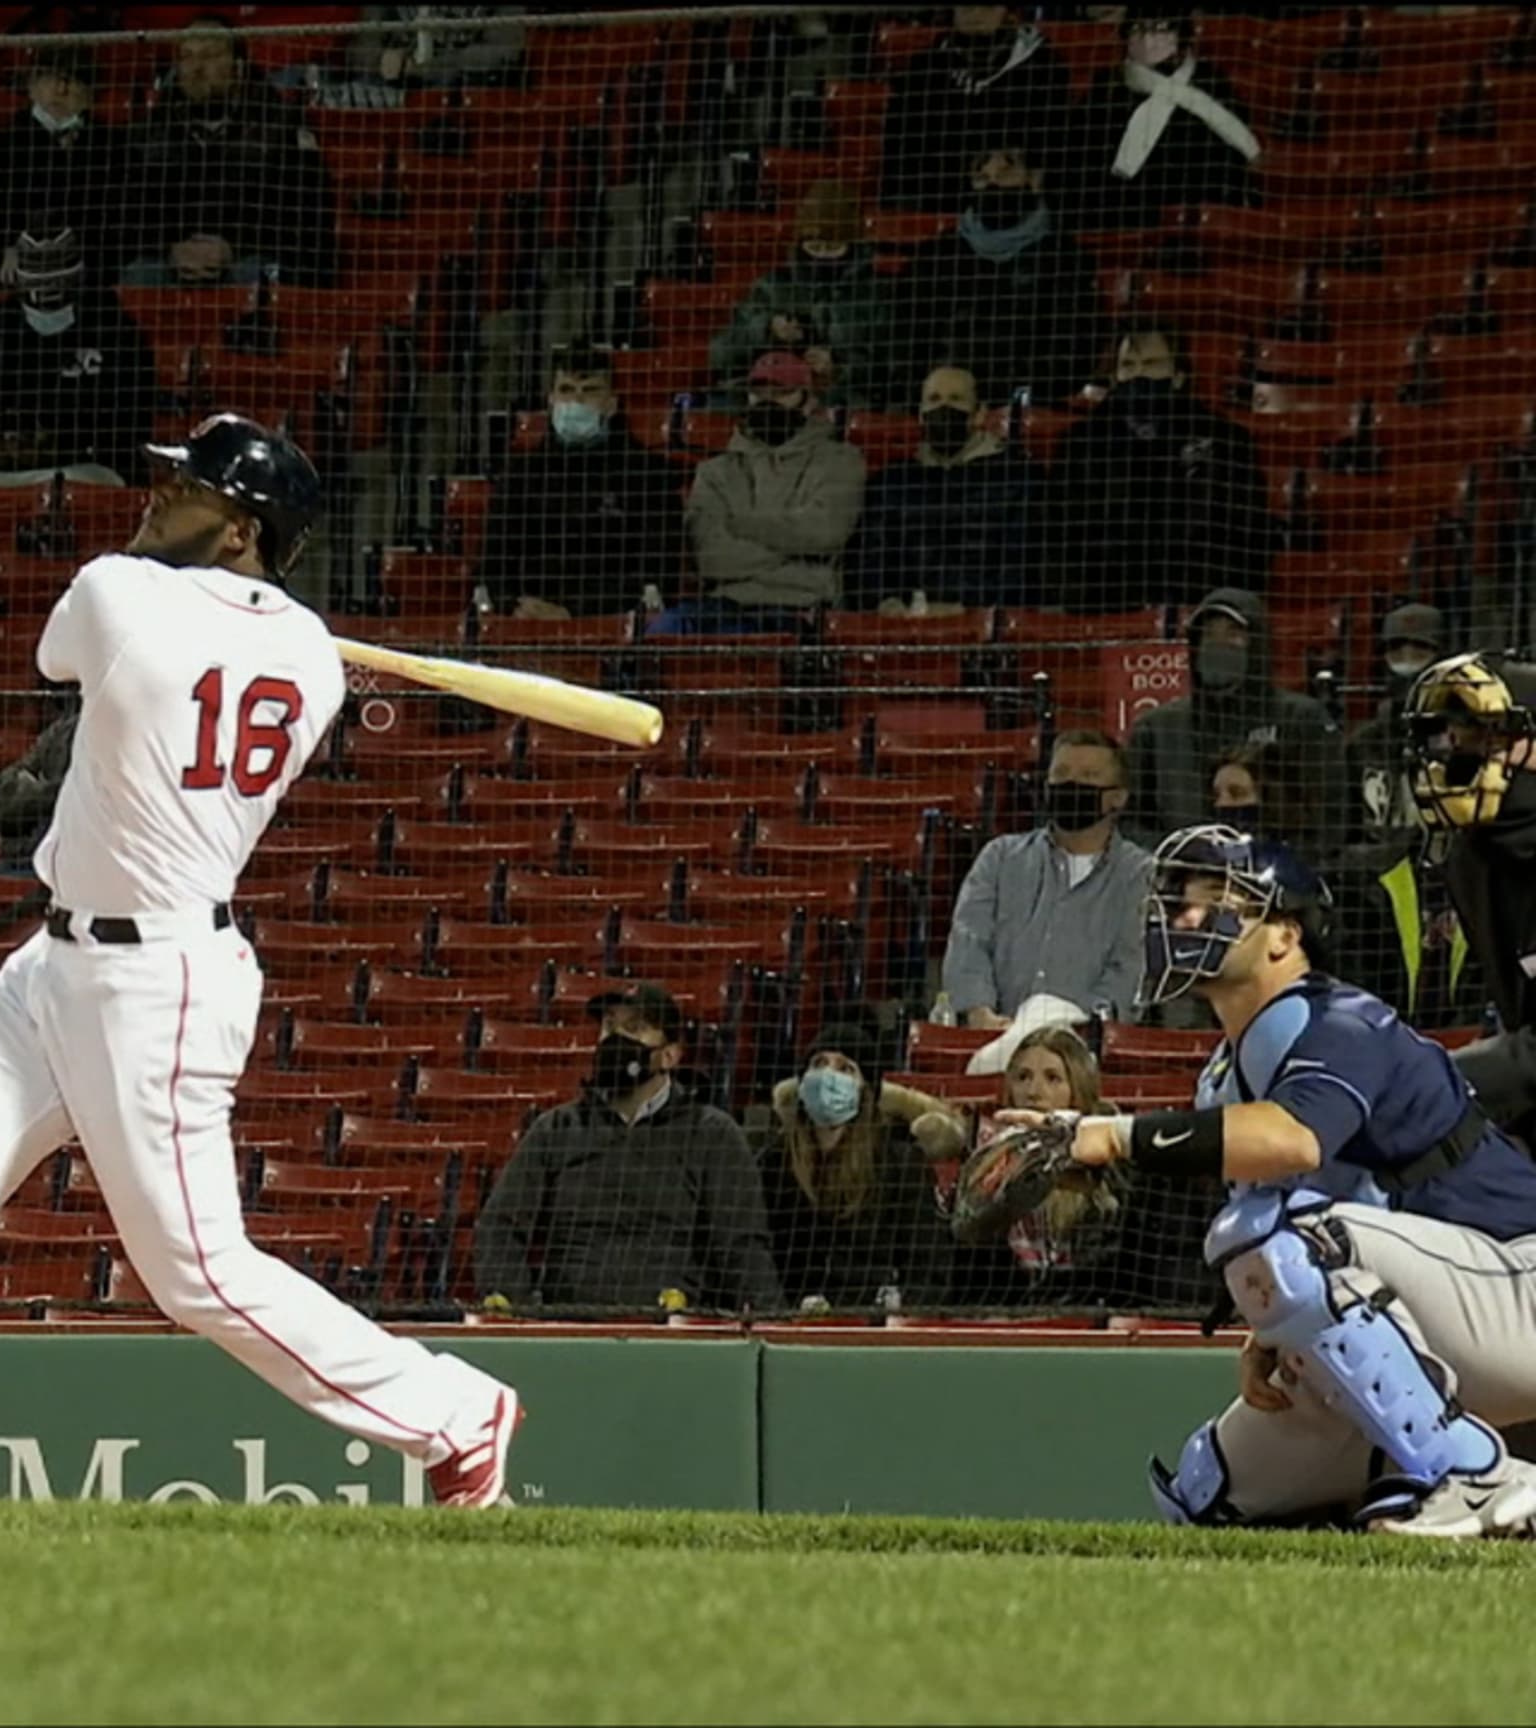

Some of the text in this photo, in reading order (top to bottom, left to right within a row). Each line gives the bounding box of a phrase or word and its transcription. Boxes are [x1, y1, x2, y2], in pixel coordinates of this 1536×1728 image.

[1123, 653, 1190, 672] LOGE
[348, 674, 382, 694] OX
[1131, 673, 1181, 691] BOX
[180, 667, 304, 798] 16
